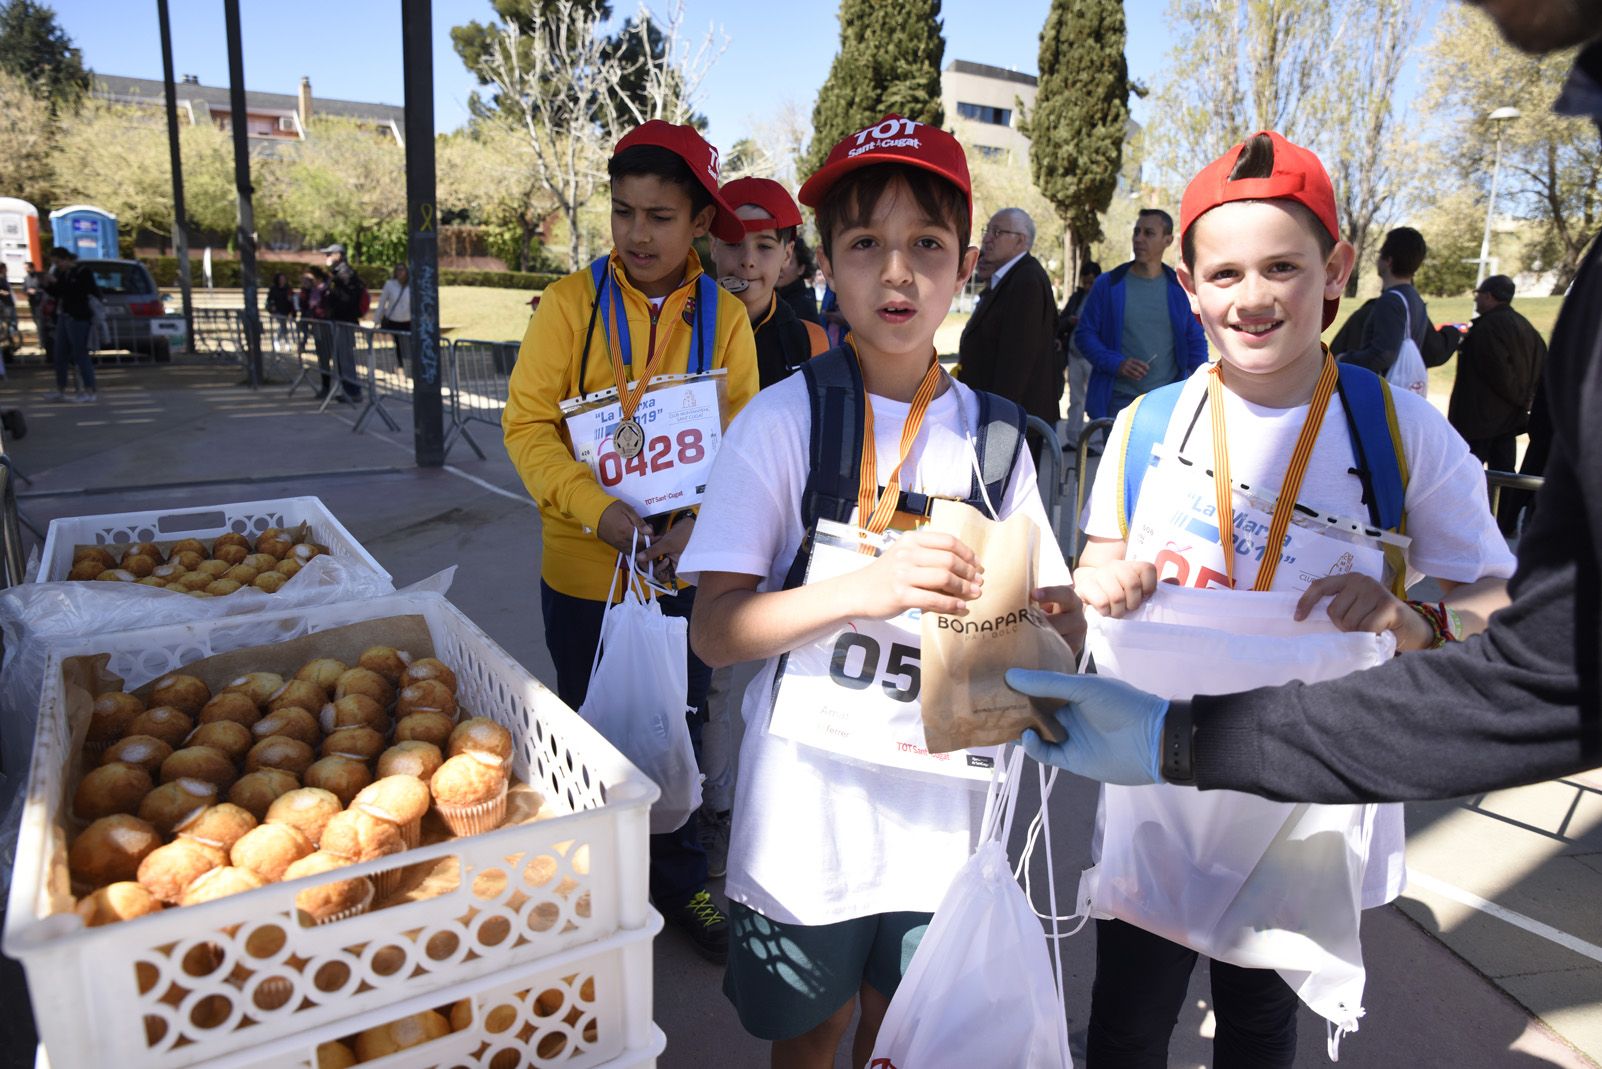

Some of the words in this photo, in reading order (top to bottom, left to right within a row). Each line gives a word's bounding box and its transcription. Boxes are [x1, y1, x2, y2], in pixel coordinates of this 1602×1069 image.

[854, 118, 924, 145] TOT
[848, 142, 876, 158] Sant
[881, 138, 922, 149] Cugat
[599, 428, 705, 488] 0428
[1232, 508, 1292, 547] Mara
[896, 741, 913, 752] TOT
